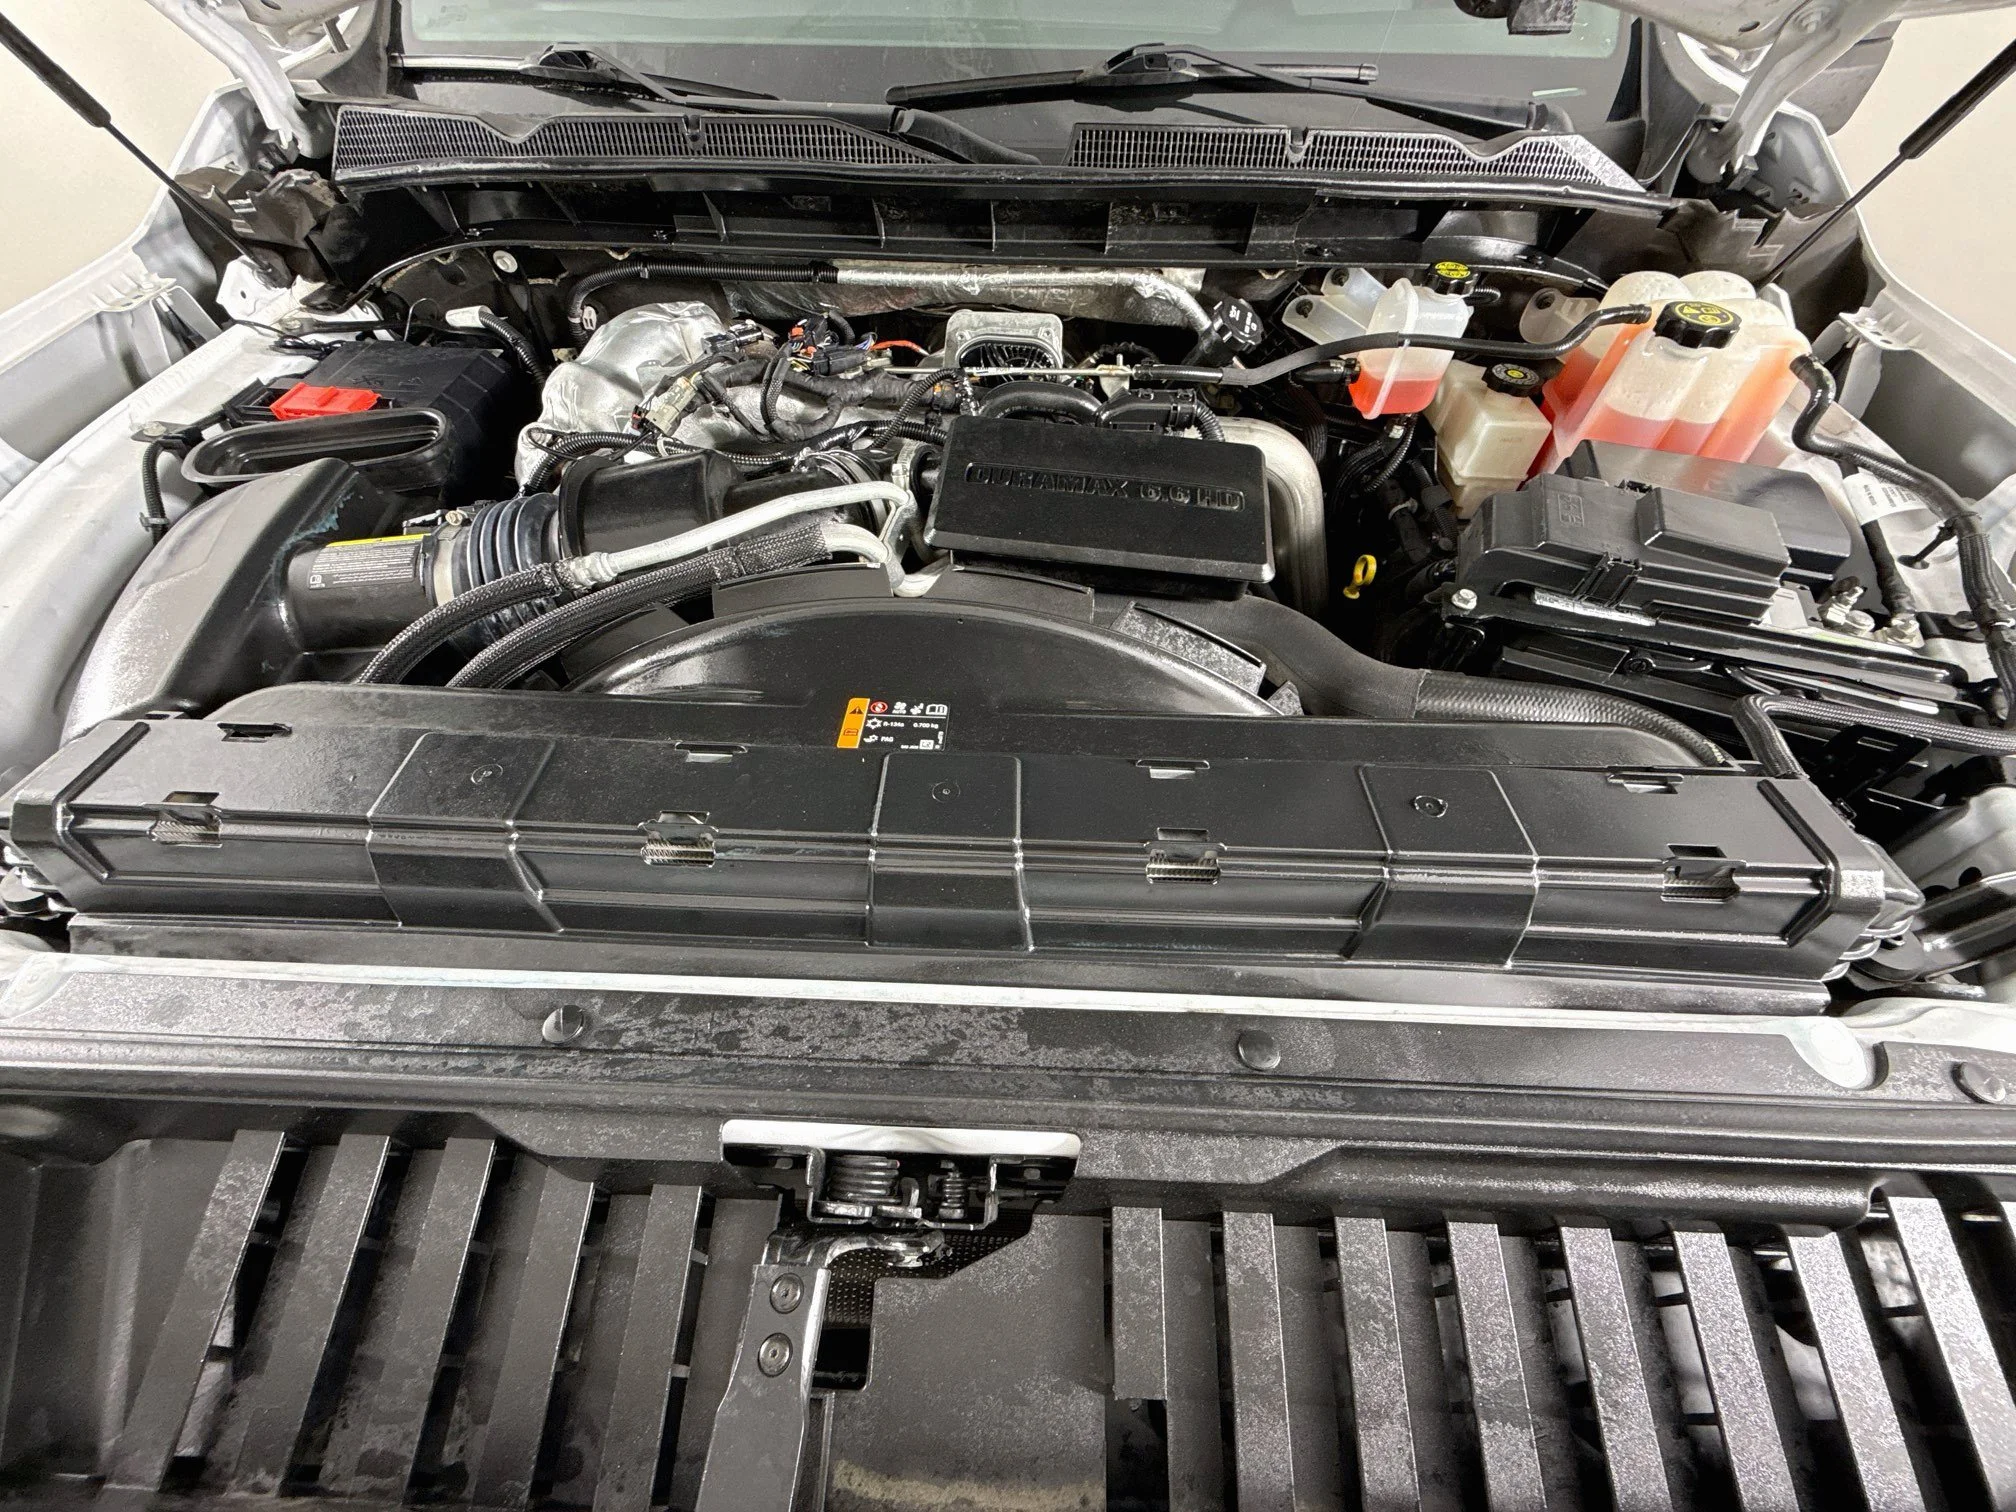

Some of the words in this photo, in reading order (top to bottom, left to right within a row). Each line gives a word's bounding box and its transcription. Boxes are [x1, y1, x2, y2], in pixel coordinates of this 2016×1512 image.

[966, 464, 1128, 498] DURAMAX
[1139, 483, 1191, 504] 6.6
[1197, 487, 1246, 511] HD
